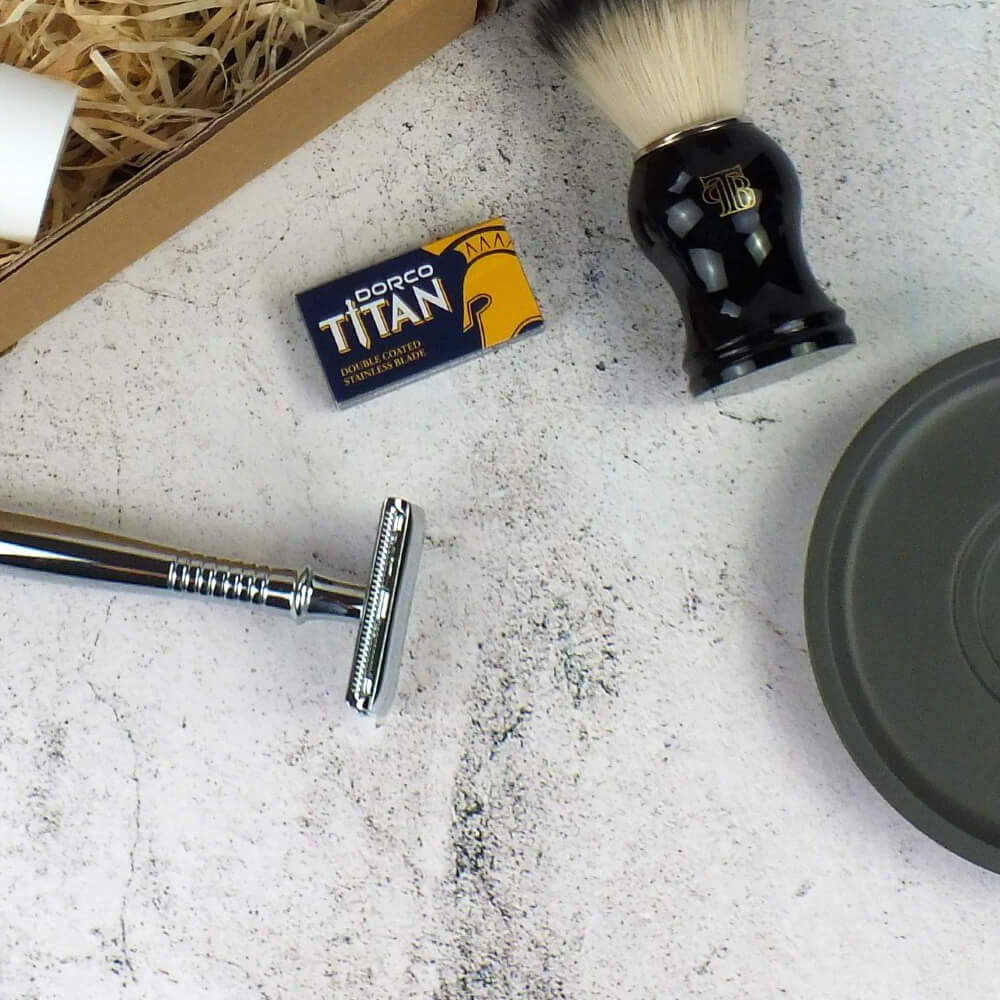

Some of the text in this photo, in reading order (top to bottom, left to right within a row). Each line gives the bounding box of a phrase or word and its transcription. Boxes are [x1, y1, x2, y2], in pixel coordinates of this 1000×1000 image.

[354, 263, 435, 303] DORCO
[318, 277, 452, 354] TITAN
[340, 339, 422, 377] DOUBLE COATED
[343, 348, 427, 386] STAINLESS BLADE
